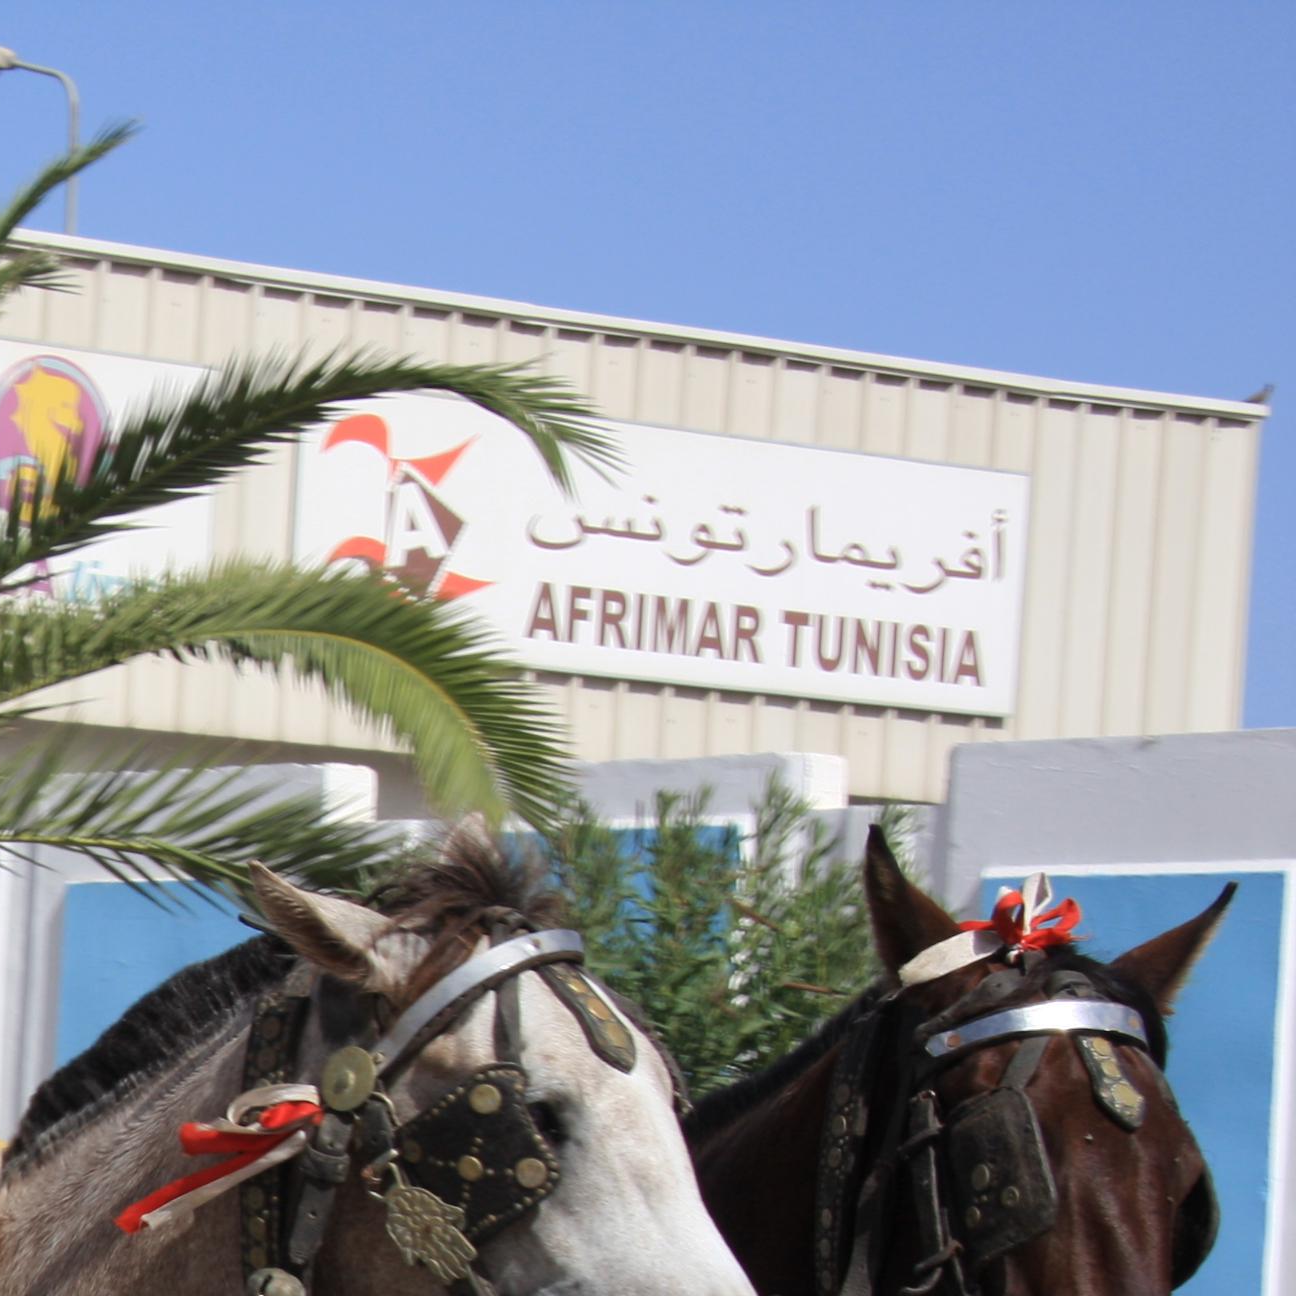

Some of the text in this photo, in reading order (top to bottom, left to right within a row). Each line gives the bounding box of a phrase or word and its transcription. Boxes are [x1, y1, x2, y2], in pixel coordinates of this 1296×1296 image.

[526, 494, 1009, 594] أفريمار تونس
[522, 580, 985, 688] AFRIMAR TUNISIA
